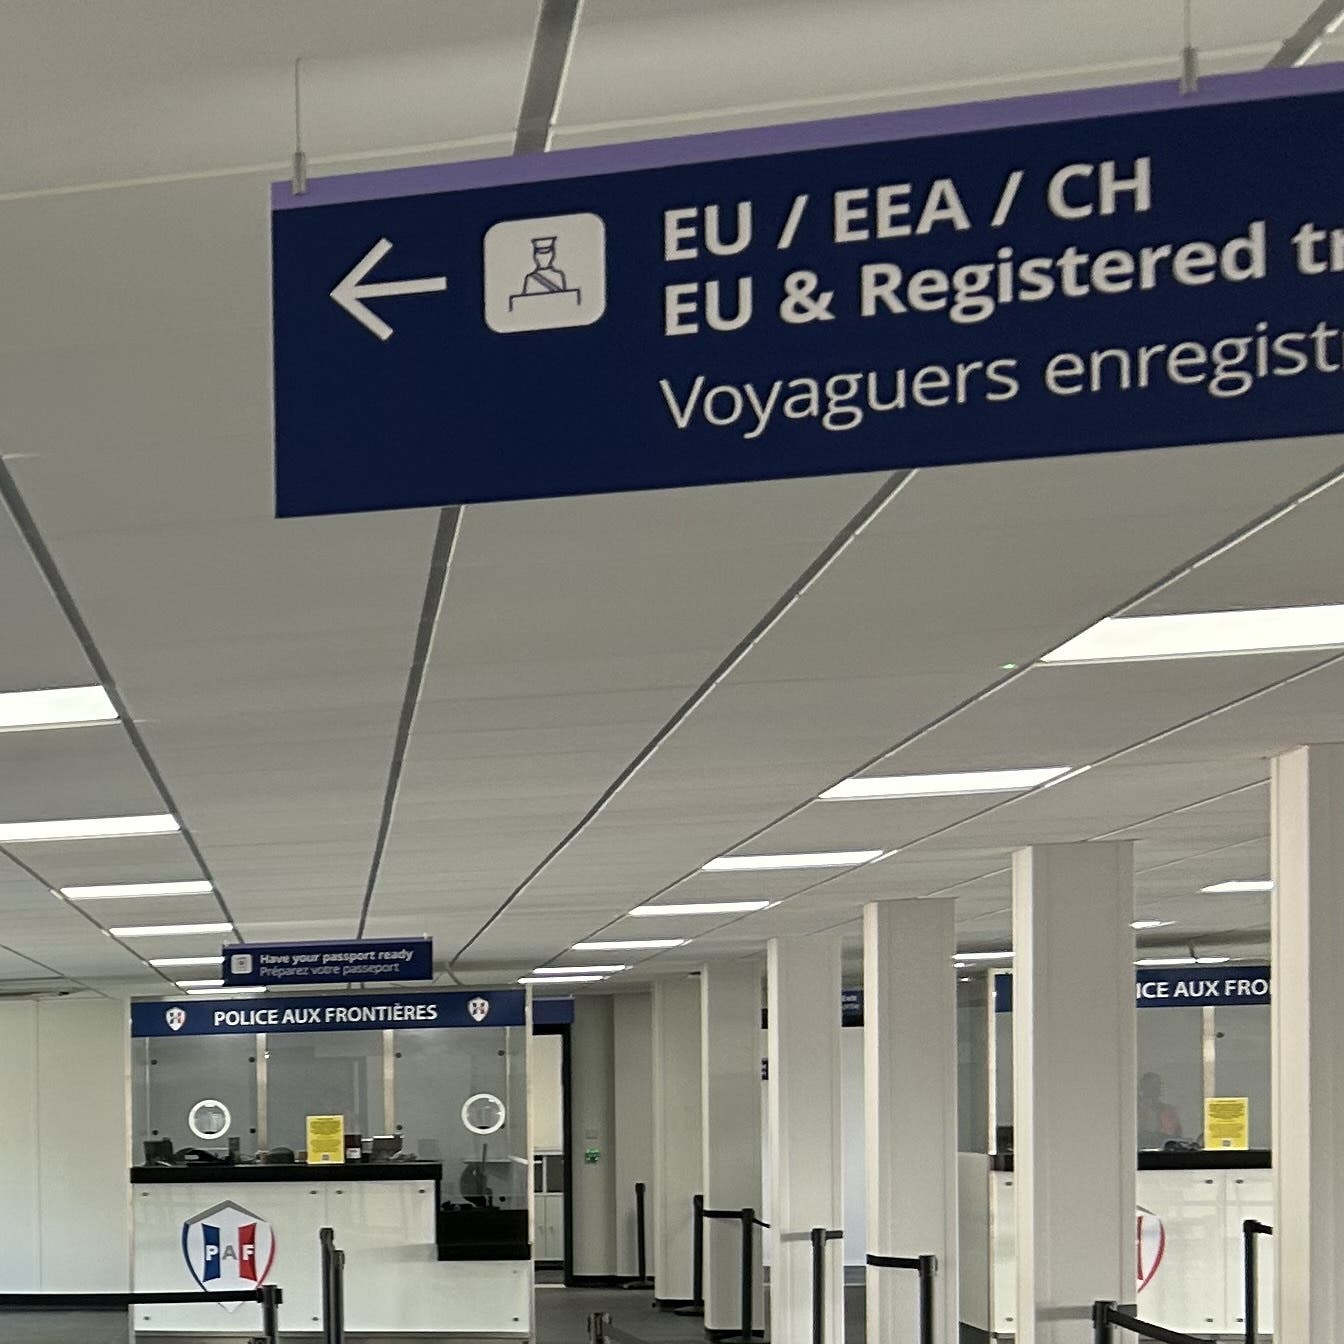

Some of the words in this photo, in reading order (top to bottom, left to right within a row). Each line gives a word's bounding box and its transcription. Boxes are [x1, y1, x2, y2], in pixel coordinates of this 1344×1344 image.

[664, 201, 753, 261] EU
[777, 194, 809, 250] /
[833, 179, 971, 243] EEA
[991, 170, 1023, 227] /
[1047, 157, 1152, 220] CH
[664, 277, 753, 336] EU
[779, 271, 836, 324] &
[860, 221, 1266, 324] Registered
[659, 357, 1019, 439] Voyaguers
[1045, 321, 1344, 398] enregist
[260, 954, 289, 965] Have
[292, 953, 321, 966] your
[323, 951, 375, 965] passport
[378, 948, 413, 961] ready
[260, 966, 310, 979] Préparez
[311, 965, 340, 975] votre
[343, 962, 400, 976] passeport
[1173, 979, 1220, 997] AUX
[1224, 978, 1271, 997] FRO
[214, 1009, 279, 1026] POLICE
[281, 1008, 321, 1025] AUX
[325, 1003, 438, 1022] FRONTIÈRES
[205, 1244, 255, 1261] PAF
